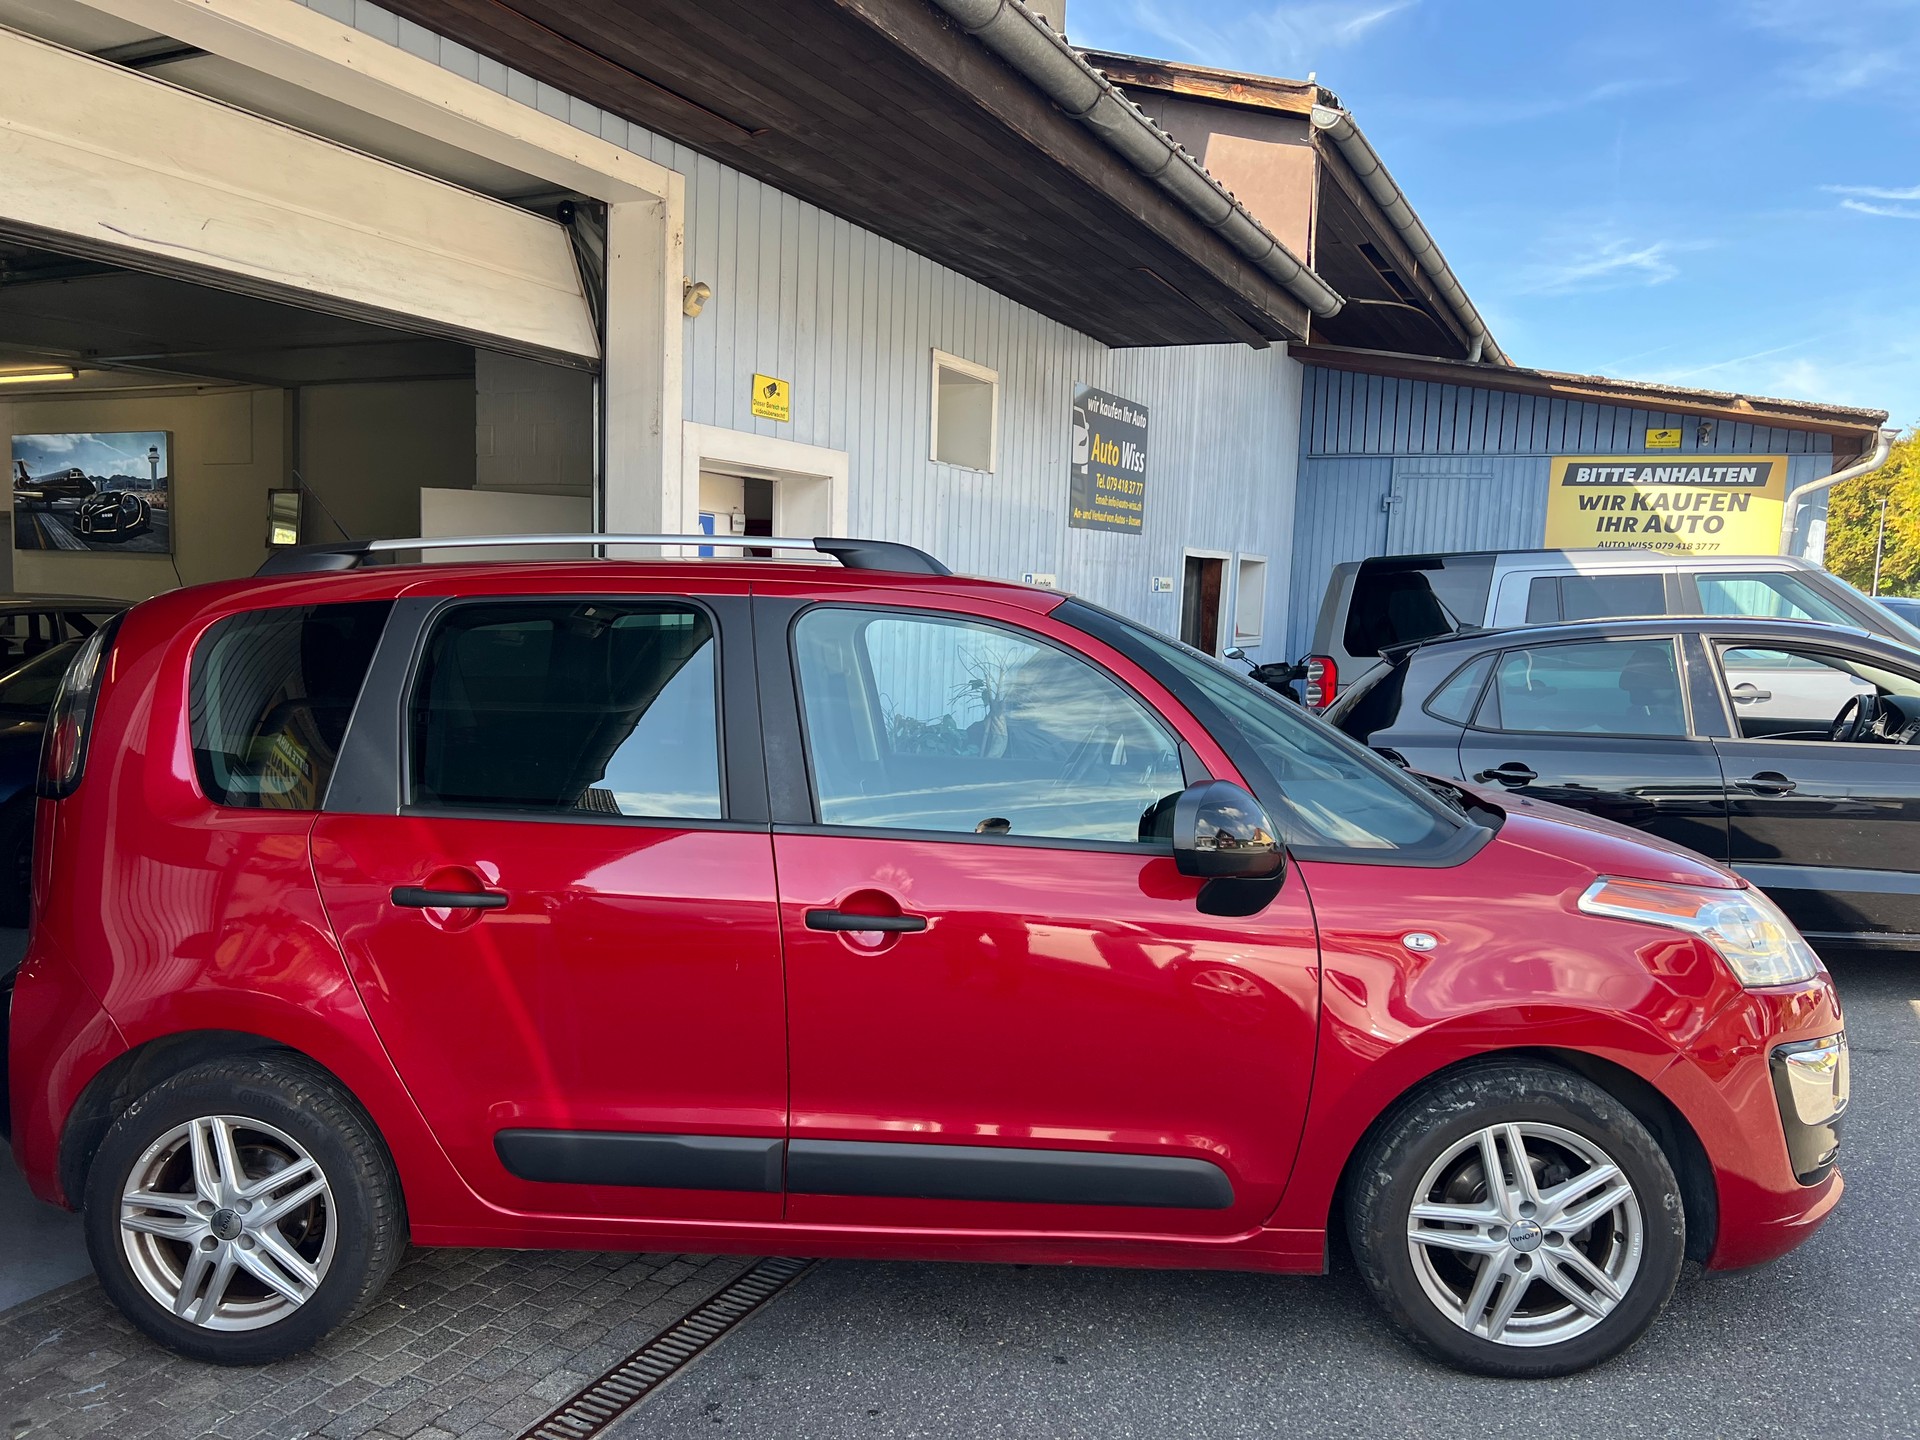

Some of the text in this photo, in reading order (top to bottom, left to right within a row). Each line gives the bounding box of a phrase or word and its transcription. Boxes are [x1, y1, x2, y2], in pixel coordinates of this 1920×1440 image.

[1088, 396, 1147, 428] wir kaufen Ihr Auto
[1091, 434, 1145, 473] Auto Wiss
[1096, 473, 1143, 496] Tel. 079 418 37 77
[1576, 467, 1757, 483] BITTE ANHALTEN
[1578, 492, 1751, 512] WIR KAUFEN
[1074, 507, 1082, 518] An-
[1596, 514, 1725, 534] IHR AUTO
[1627, 541, 1654, 549] WISS
[1655, 542, 1674, 550] 079
[1511, 1232, 1535, 1242] RONAL
